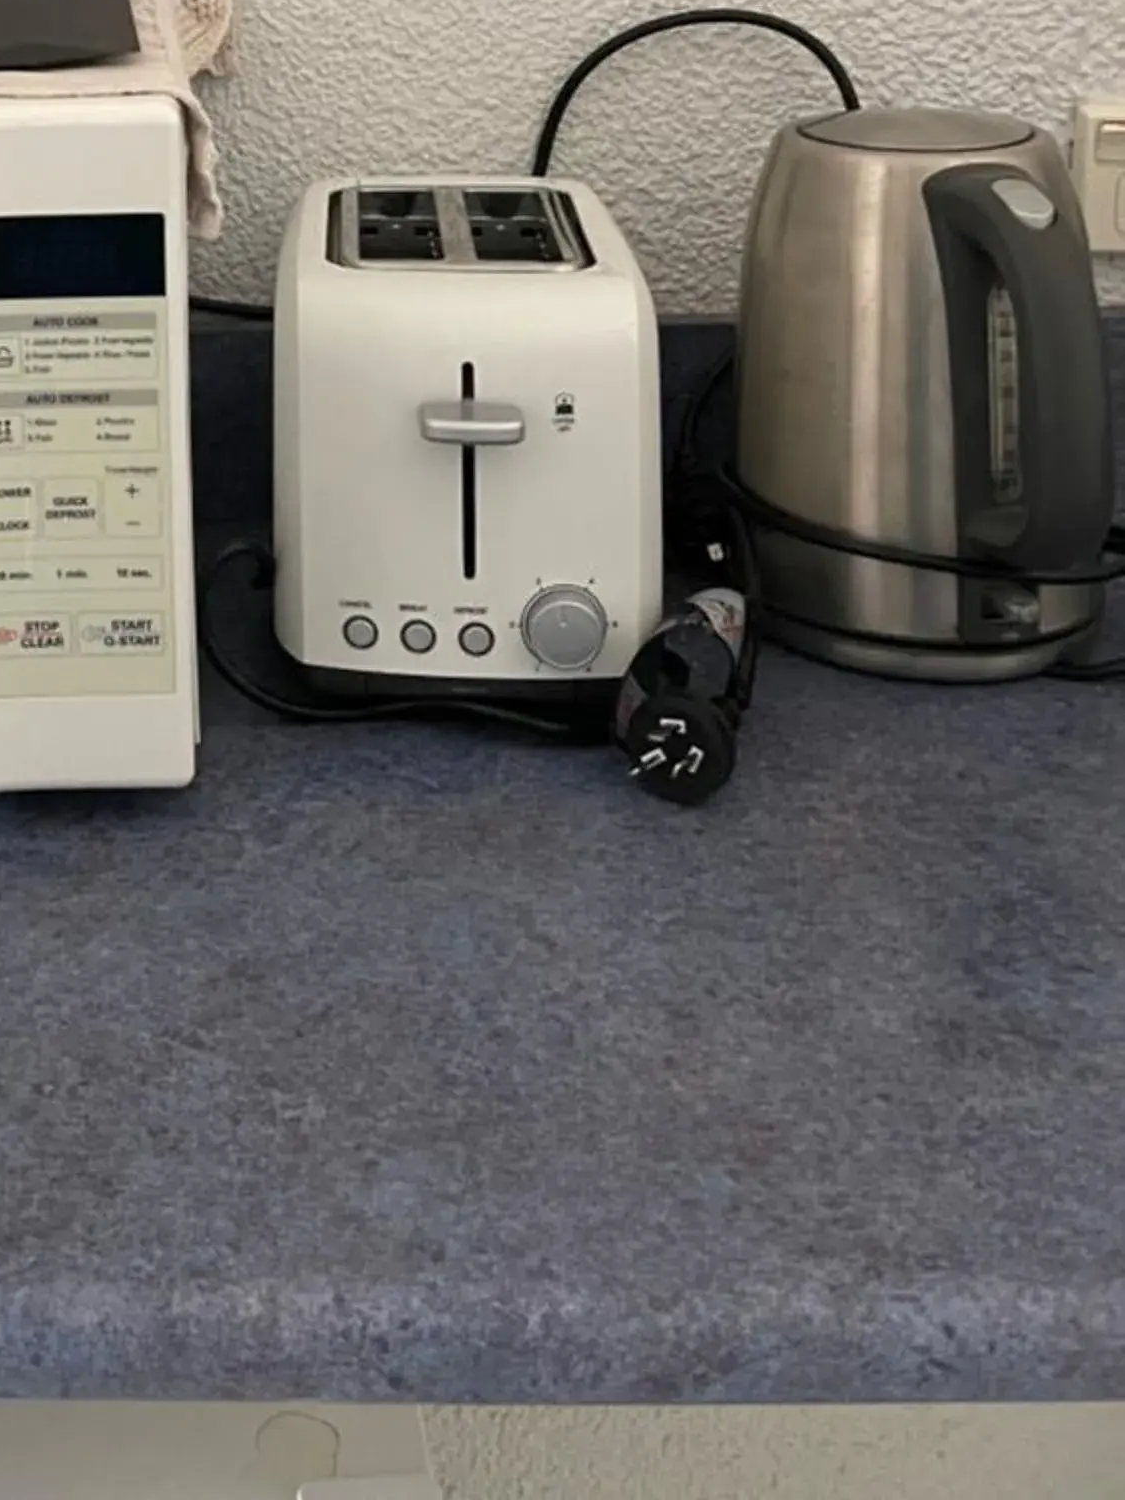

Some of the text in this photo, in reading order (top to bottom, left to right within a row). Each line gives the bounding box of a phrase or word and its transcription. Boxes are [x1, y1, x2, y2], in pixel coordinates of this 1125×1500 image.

[33, 315, 98, 327] AUTO COOK
[26, 393, 57, 404] AUTO
[52, 496, 88, 507] QUICK
[45, 508, 96, 520] DEFROST
[24, 621, 60, 633] STOP
[111, 618, 154, 632] START
[21, 634, 65, 649] CLEAR
